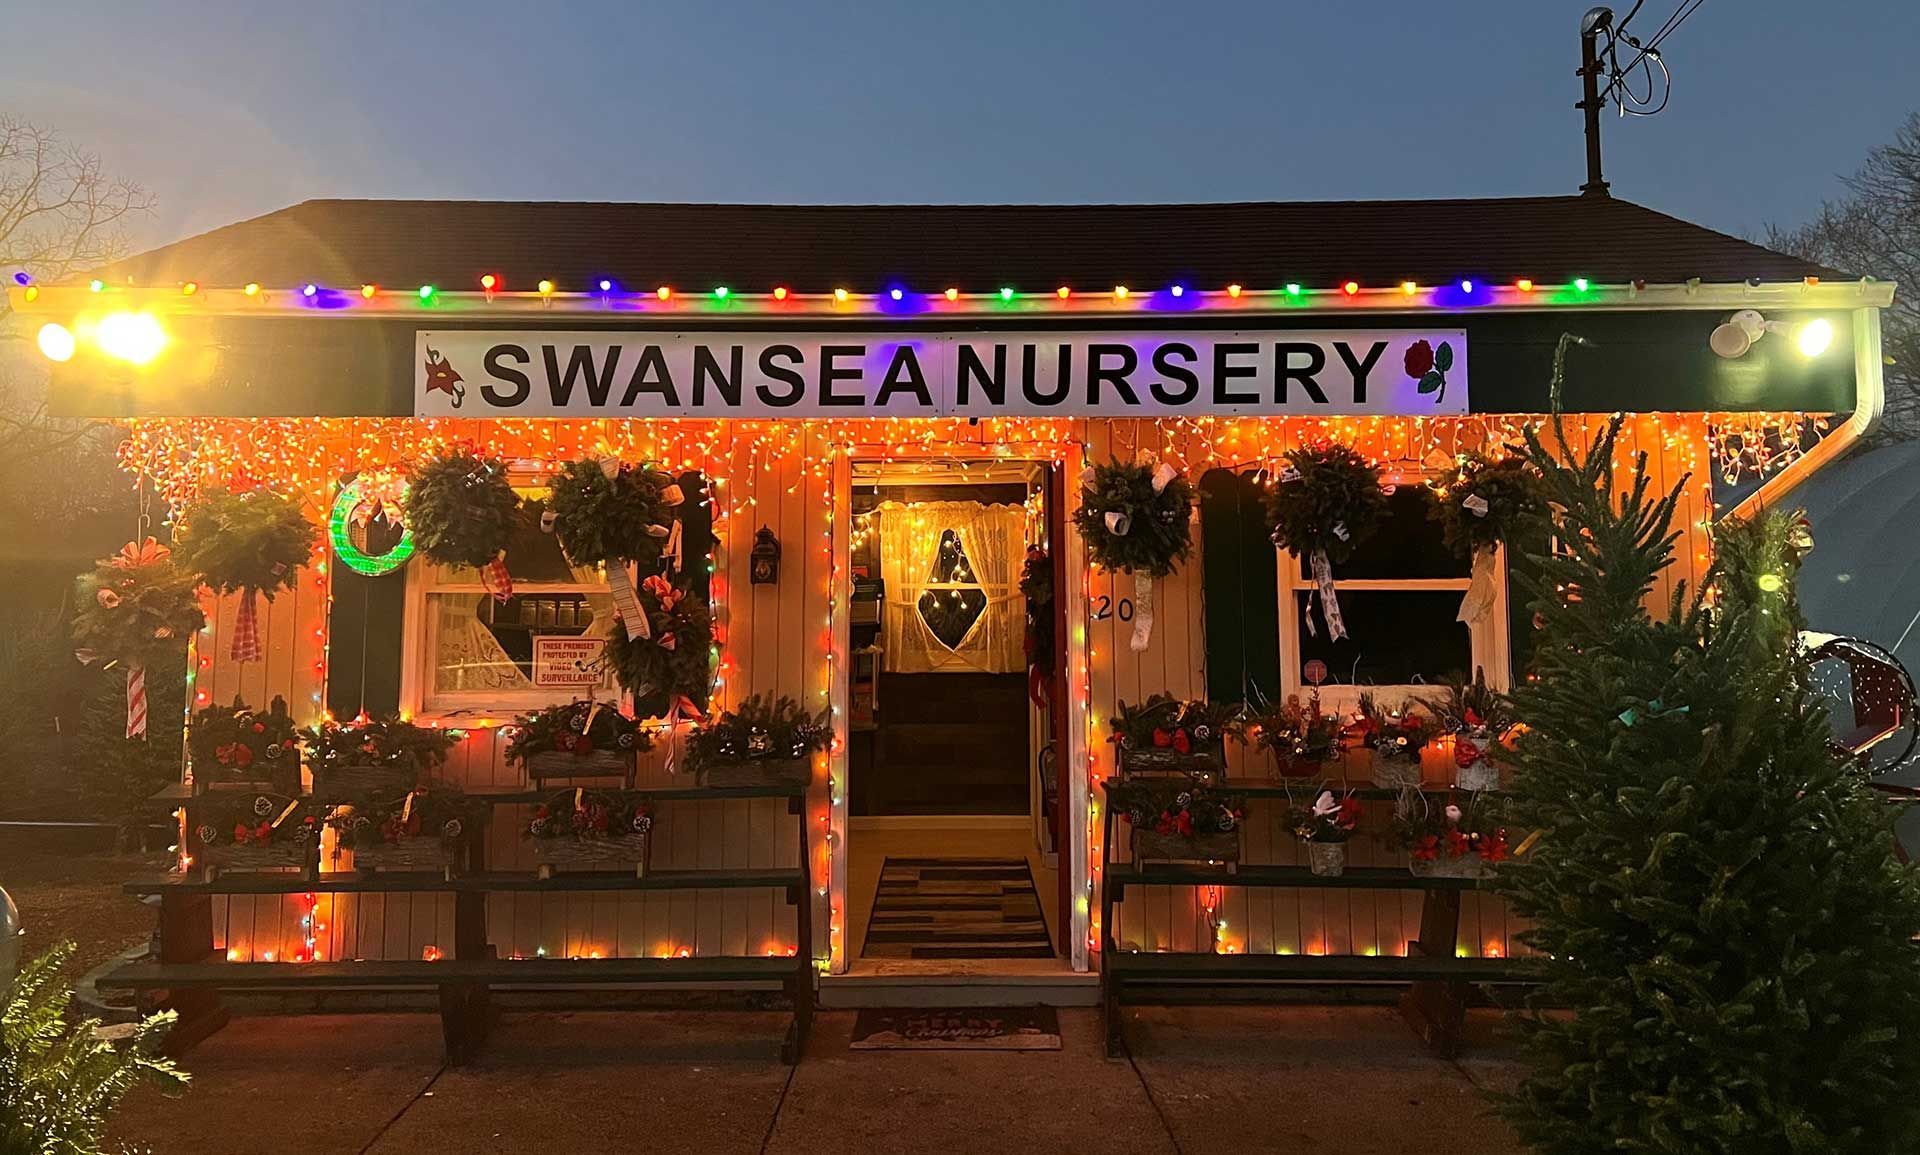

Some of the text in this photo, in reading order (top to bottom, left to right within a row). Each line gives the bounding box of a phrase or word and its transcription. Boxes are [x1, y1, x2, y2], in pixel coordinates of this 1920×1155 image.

[480, 341, 1389, 408] SWANSEA NURSERY
[1098, 595, 1134, 622] 20
[550, 662, 571, 671] VIDEO
[541, 673, 597, 682] SURVEILLANCE
